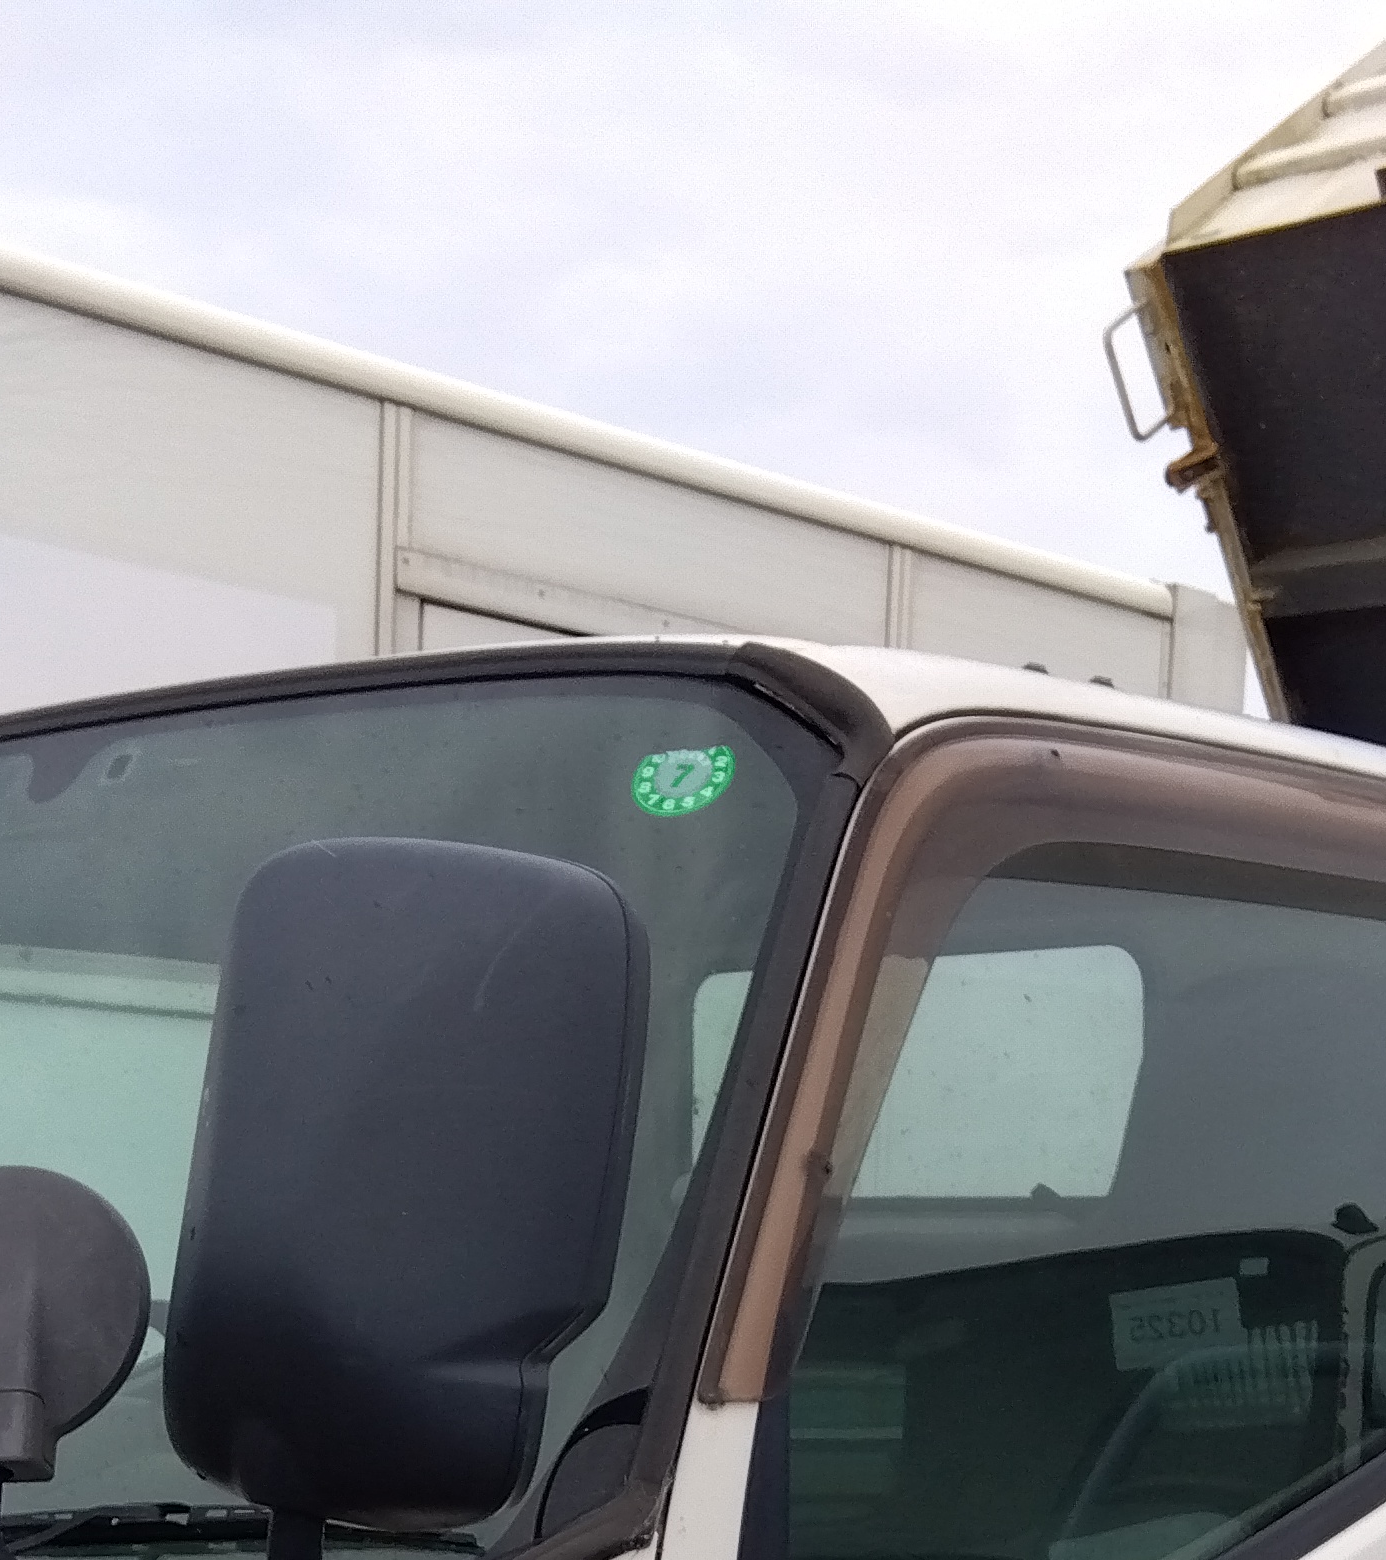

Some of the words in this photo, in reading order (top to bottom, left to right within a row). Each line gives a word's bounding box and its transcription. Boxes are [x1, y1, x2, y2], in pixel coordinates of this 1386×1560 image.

[642, 766, 655, 778] 9
[671, 763, 695, 788] 7
[712, 771, 726, 783] 3
[700, 786, 713, 797] 4
[648, 794, 660, 805] 7
[662, 798, 676, 810] 6
